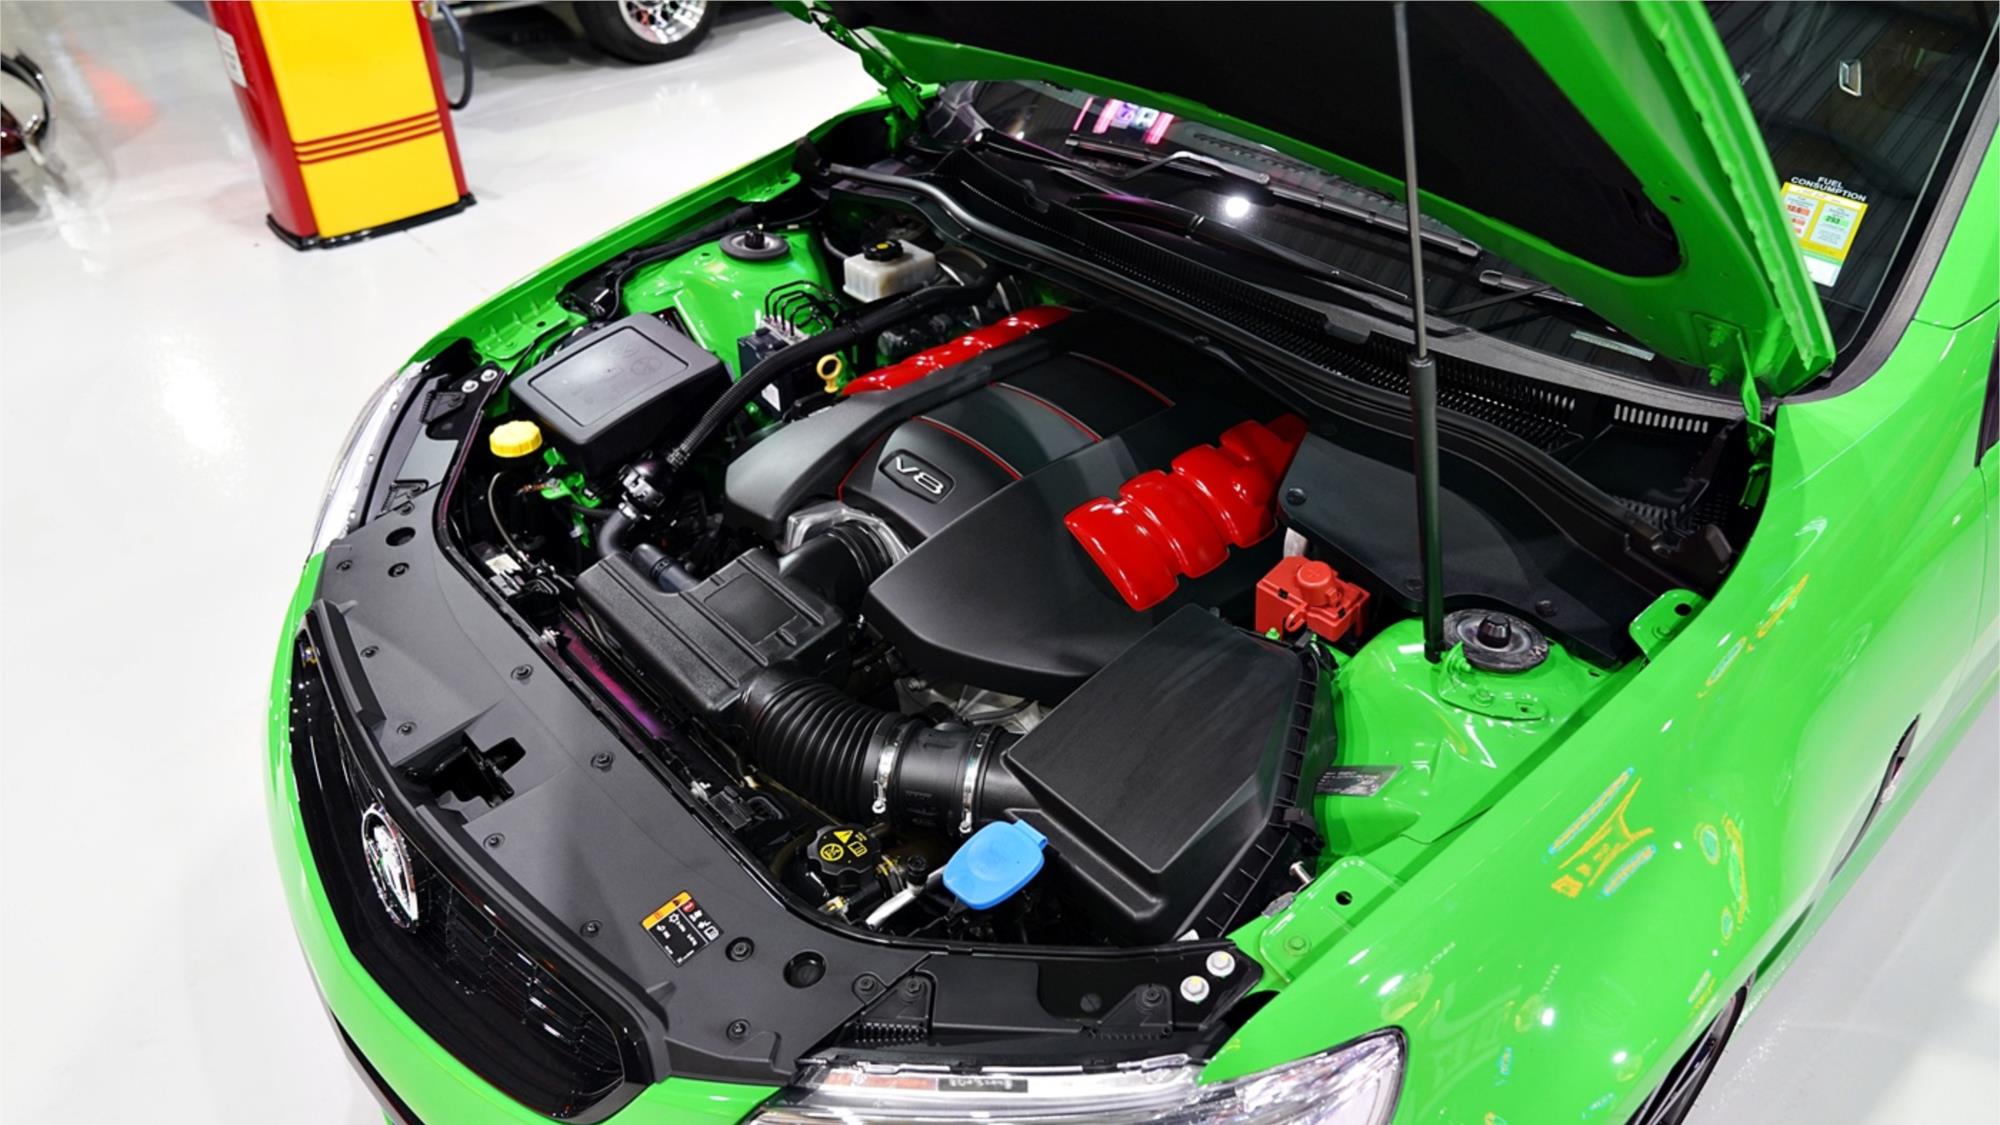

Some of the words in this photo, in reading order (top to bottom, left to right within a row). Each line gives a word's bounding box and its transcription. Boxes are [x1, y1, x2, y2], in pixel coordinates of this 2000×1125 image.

[1790, 176, 1867, 202] CONSUMPTION
[1818, 176, 1844, 189] FUEL
[896, 456, 944, 495] V8
